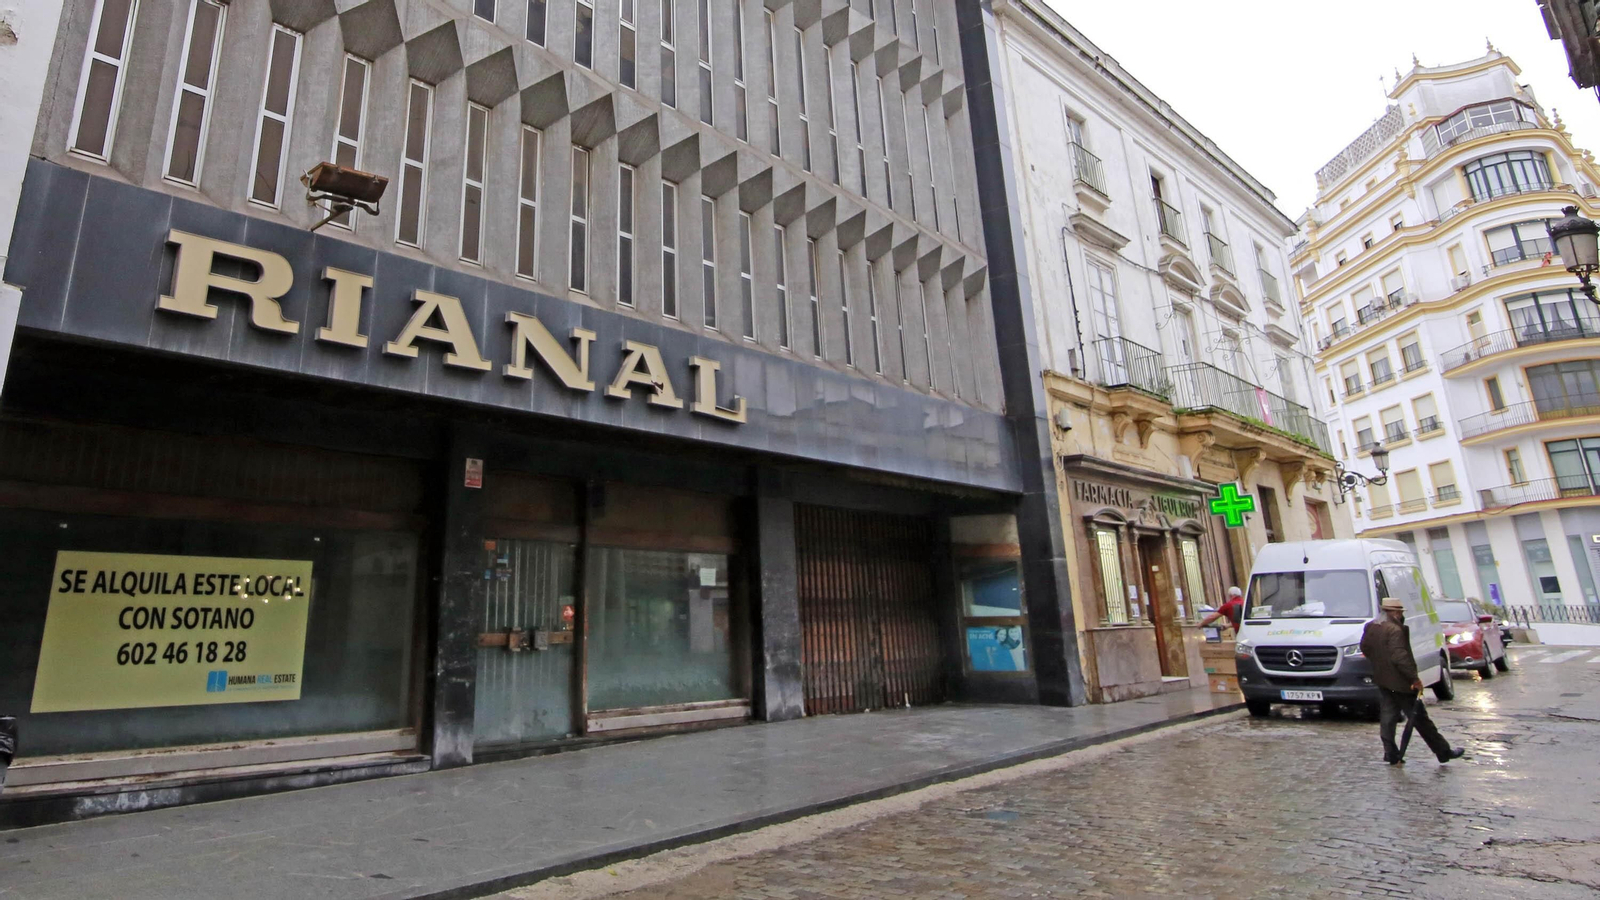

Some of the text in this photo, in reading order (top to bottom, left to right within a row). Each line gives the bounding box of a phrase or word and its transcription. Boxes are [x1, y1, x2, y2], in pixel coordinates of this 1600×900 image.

[155, 228, 748, 424] RIANAL
[1074, 480, 1134, 509] FARMACIA
[58, 569, 304, 597] SE ALQUILA ESTE LOCAL
[118, 606, 255, 630] CON SOTANO
[116, 640, 247, 666] 602 46 18 28
[228, 673, 296, 685] HUMANA REAL ESTATE
